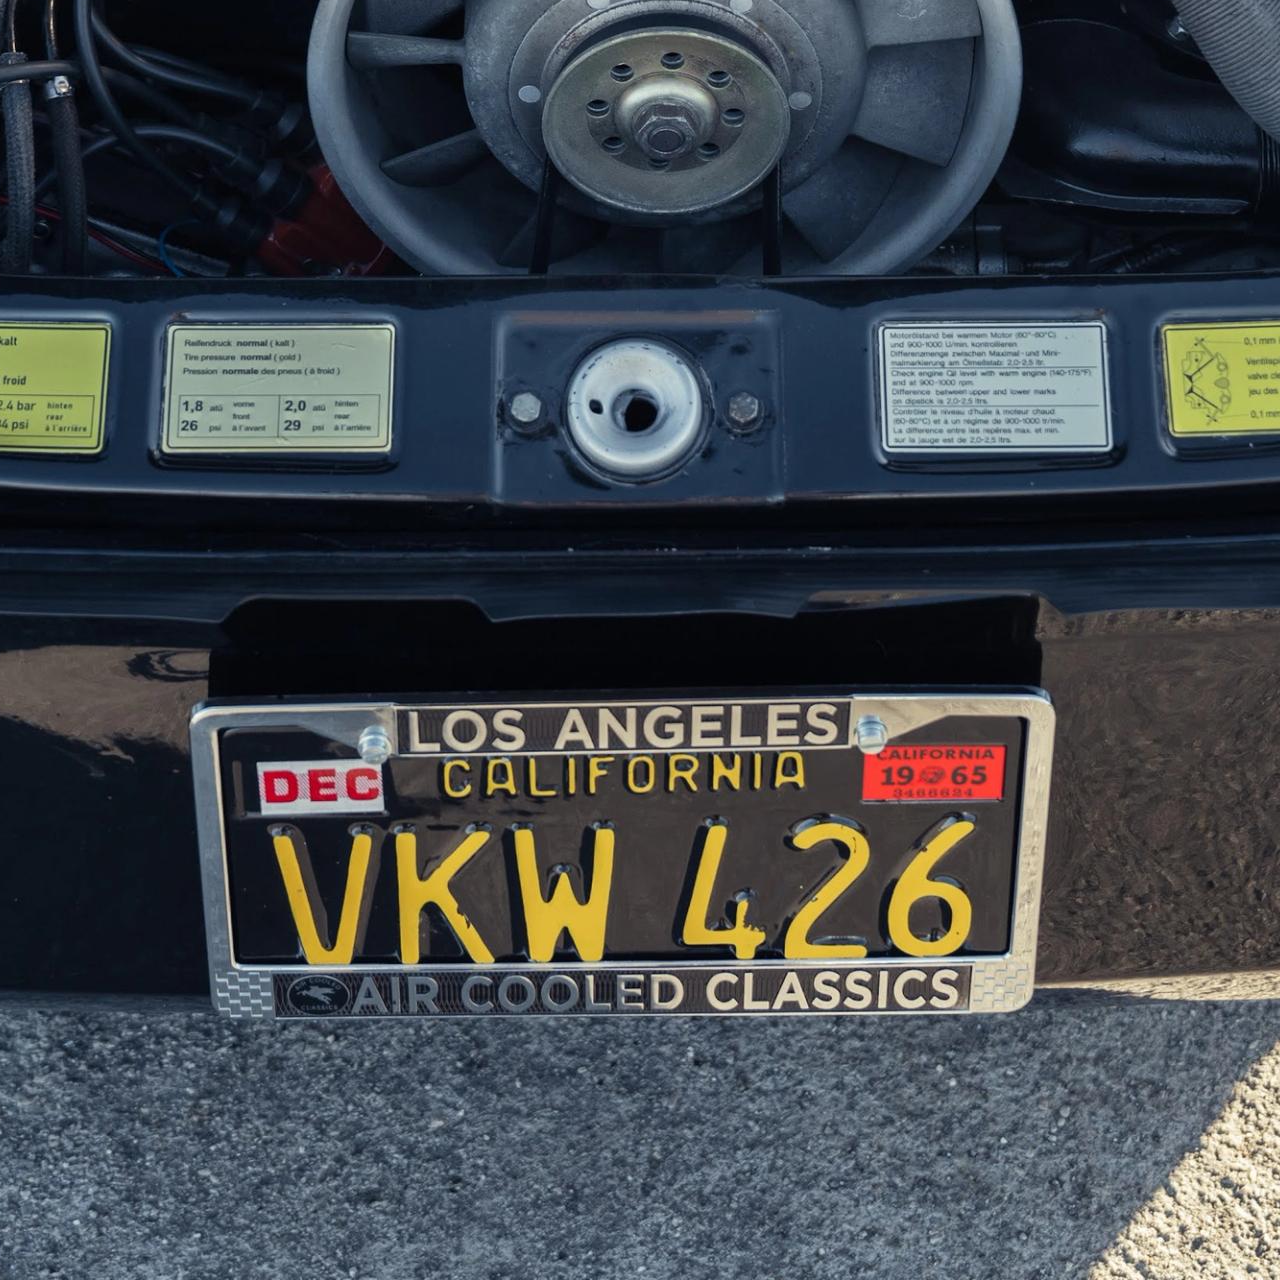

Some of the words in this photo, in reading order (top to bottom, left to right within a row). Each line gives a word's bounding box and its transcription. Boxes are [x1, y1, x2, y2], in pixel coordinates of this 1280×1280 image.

[184, 339, 232, 347] Reifendruck
[236, 339, 268, 347] normal
[274, 339, 290, 347] kalt
[1259, 337, 1276, 345] mm
[184, 353, 199, 361] Tire
[200, 354, 236, 362] pressure
[240, 353, 272, 361] normal
[279, 353, 296, 361] cold
[183, 367, 218, 375] Pression
[222, 367, 259, 375] normale
[260, 367, 276, 375] des
[277, 368, 303, 377] pneus
[317, 367, 335, 375] froid
[918, 370, 944, 378] engine
[1021, 370, 1047, 378] engine
[1247, 372, 1269, 380] valve
[3, 375, 27, 386] froid
[891, 388, 931, 396] Difference
[935, 388, 968, 396] between
[1248, 388, 1261, 398] jeu
[1263, 387, 1279, 395] des
[17, 400, 37, 411] bar
[47, 401, 73, 410] hinten
[182, 400, 204, 414] 1,8
[284, 400, 307, 414] 2,0
[334, 400, 359, 408] hinten
[904, 398, 935, 406] dipstick
[46, 413, 64, 421] rear
[12, 419, 30, 432] psi
[180, 420, 199, 432] 26
[208, 424, 222, 433] psi
[284, 420, 302, 432] 29
[312, 424, 325, 433] psi
[406, 709, 526, 753] LOS
[553, 702, 839, 752] ANGELES
[876, 748, 995, 761] CALIFORNIA
[441, 751, 806, 799] CALIFORNIA
[880, 765, 914, 786] 19
[951, 765, 987, 786] 65
[262, 767, 381, 803] DEC
[272, 826, 616, 965] VKW
[682, 817, 976, 960] 426
[351, 975, 441, 1014] AIR
[459, 973, 685, 1014] COOLED
[705, 968, 960, 1012] CLASSICS
